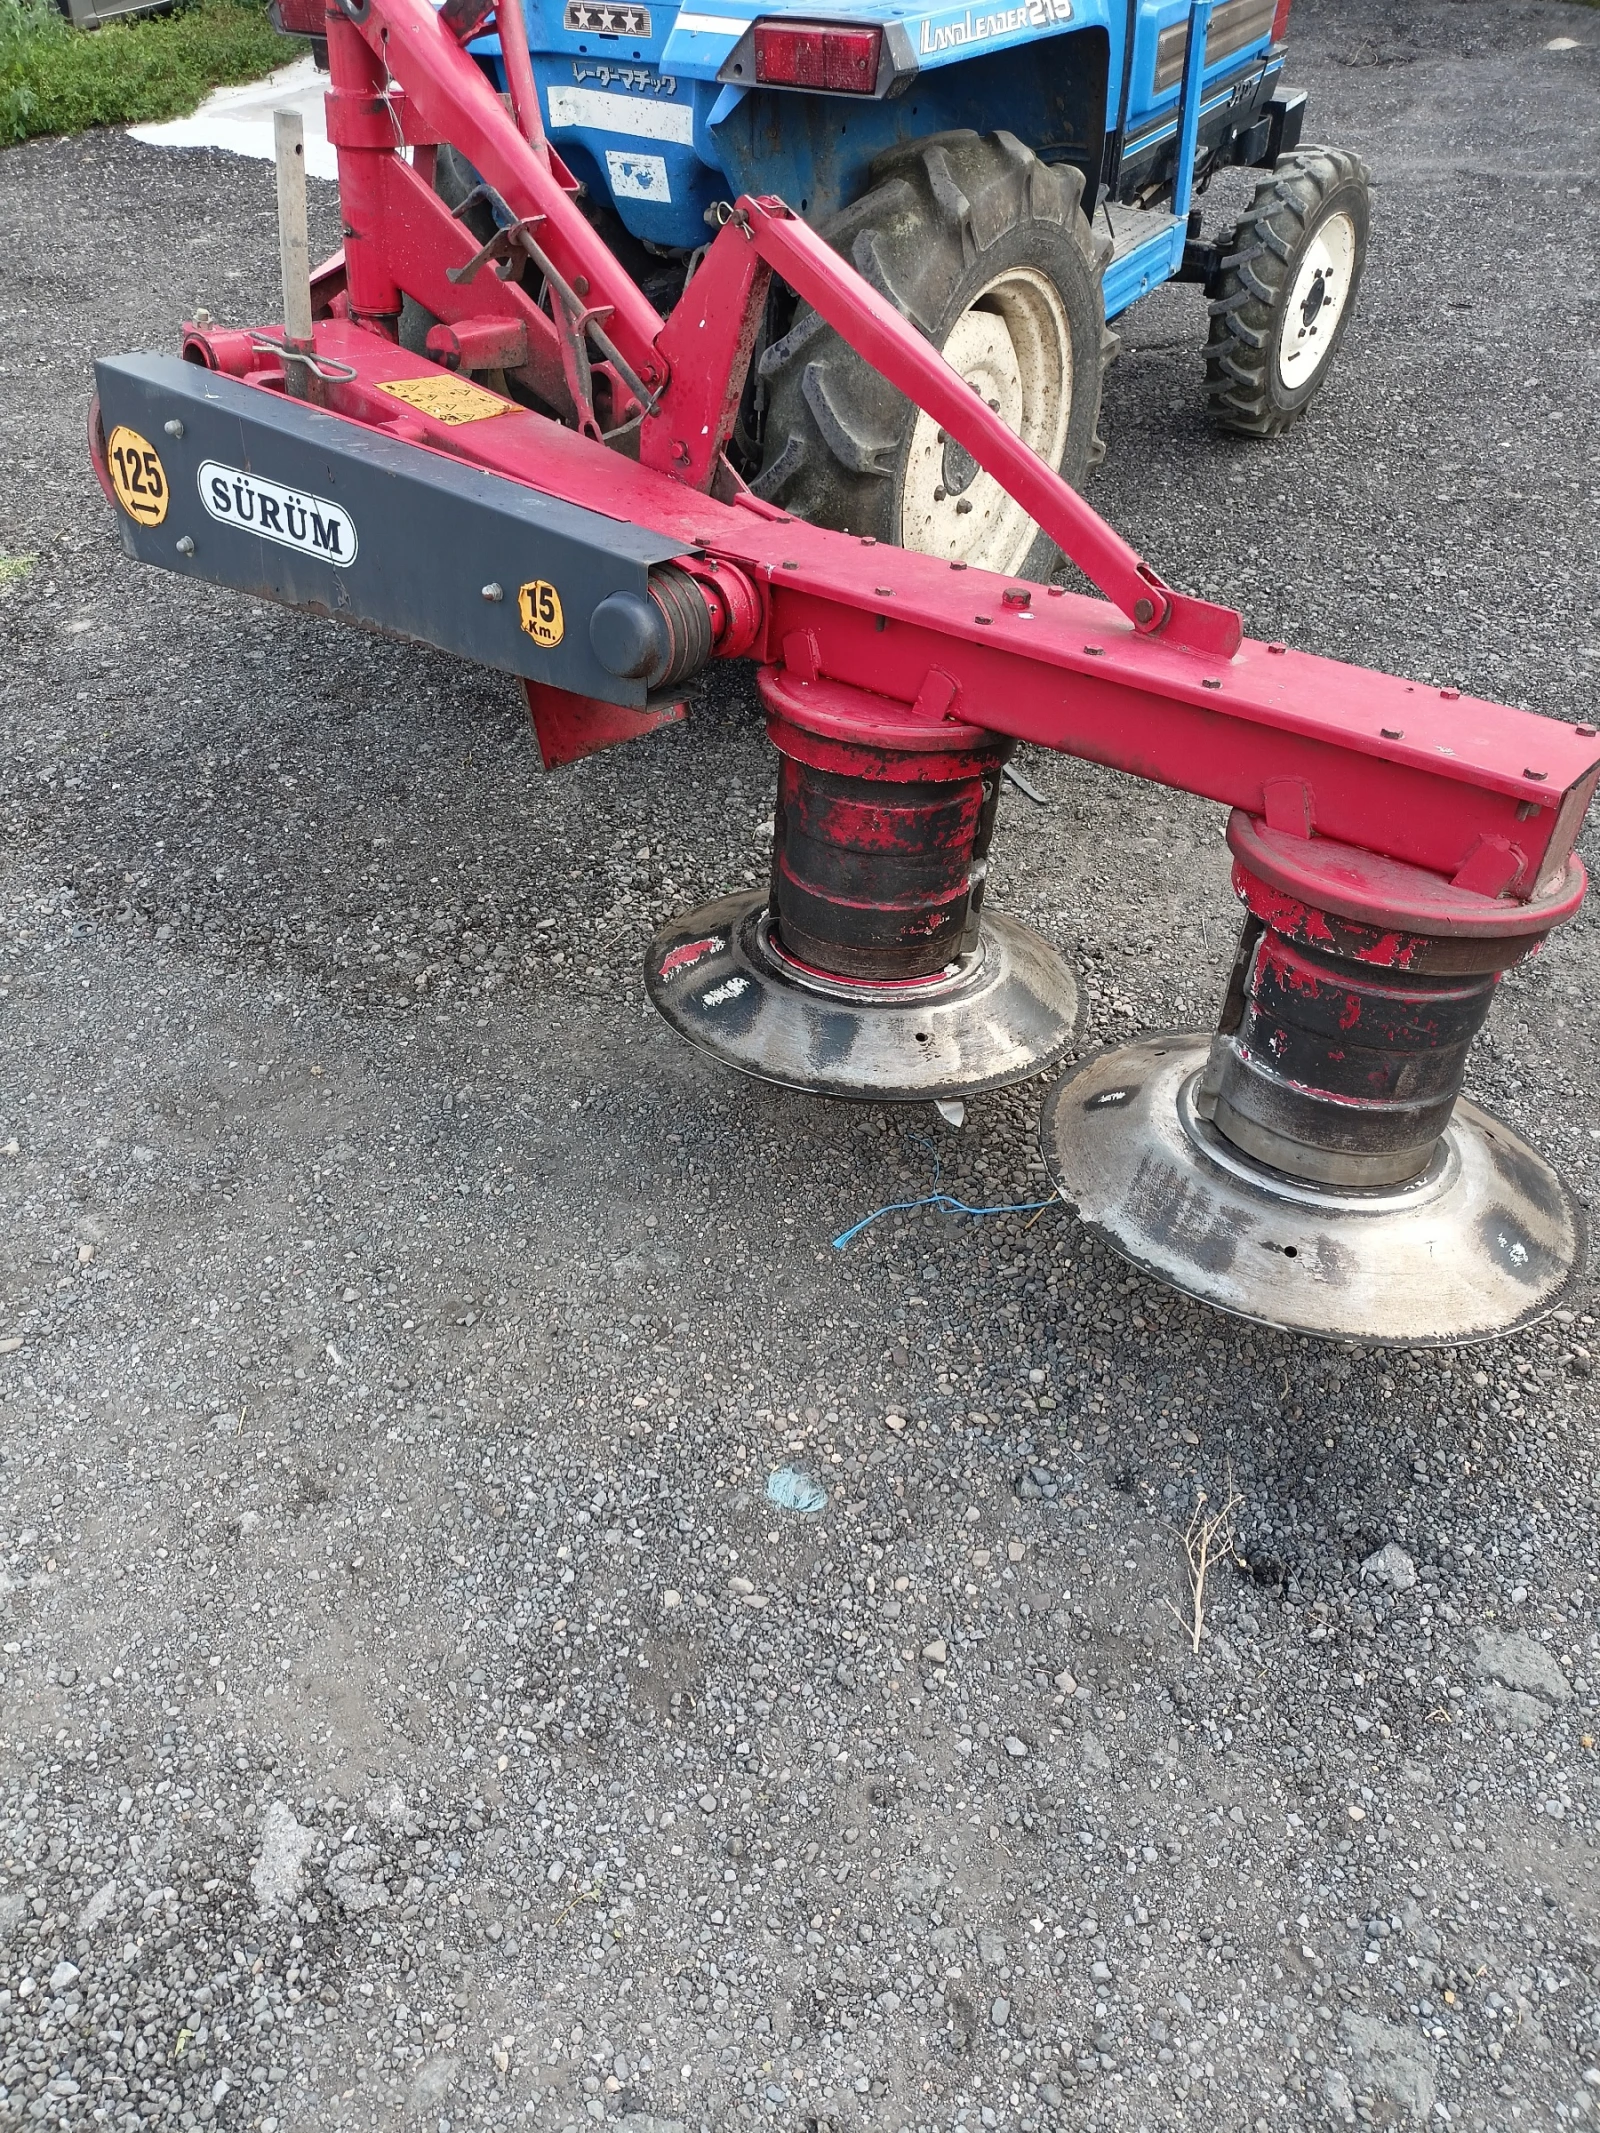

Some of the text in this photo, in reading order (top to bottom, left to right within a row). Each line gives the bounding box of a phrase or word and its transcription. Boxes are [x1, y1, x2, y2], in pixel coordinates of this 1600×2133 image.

[572, 62, 677, 96] レーダーマチック
[113, 446, 163, 499] 125
[211, 476, 343, 556] SÜRÜM
[526, 586, 555, 623] 15
[528, 619, 556, 641] Km.
